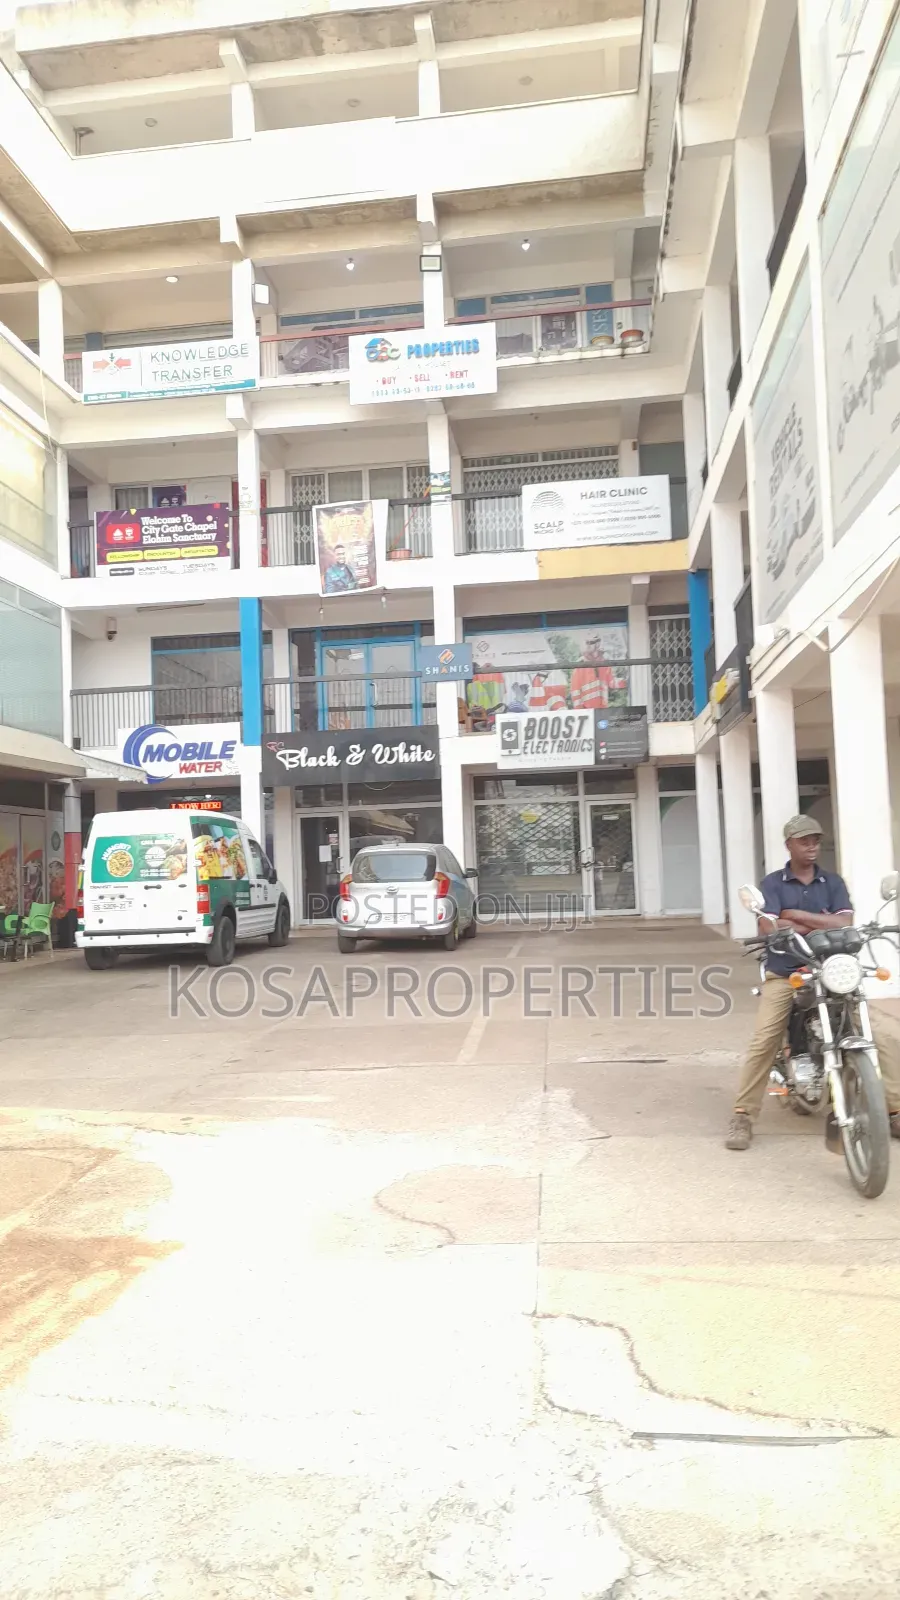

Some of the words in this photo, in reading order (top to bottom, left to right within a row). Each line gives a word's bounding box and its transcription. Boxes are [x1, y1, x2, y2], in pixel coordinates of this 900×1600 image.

[150, 342, 250, 363] KNOWLEDGE
[407, 338, 480, 359] PROPERTIES
[152, 364, 233, 382] TRANSFER
[382, 377, 396, 385] BUY
[414, 374, 431, 382] SELL
[450, 370, 469, 379] RENT
[580, 490, 607, 500] HAIR
[609, 486, 648, 497] CLINIC
[141, 515, 181, 526] Welcome
[181, 514, 193, 523] To
[534, 520, 564, 530] SCALP
[141, 525, 160, 538] City
[161, 523, 184, 534] Gate
[185, 521, 217, 533] Chapel
[142, 533, 172, 544] Elohim
[173, 532, 217, 544] Sanctuary
[425, 664, 470, 675] SHANIS
[524, 715, 588, 740] BOOST
[142, 740, 236, 763] MOBILE
[522, 738, 593, 754] ELECTRONICS
[276, 745, 341, 771] Black
[346, 743, 366, 766] &
[371, 741, 436, 765] White
[179, 761, 223, 774] WATER
[178, 802, 199, 810] NOW
